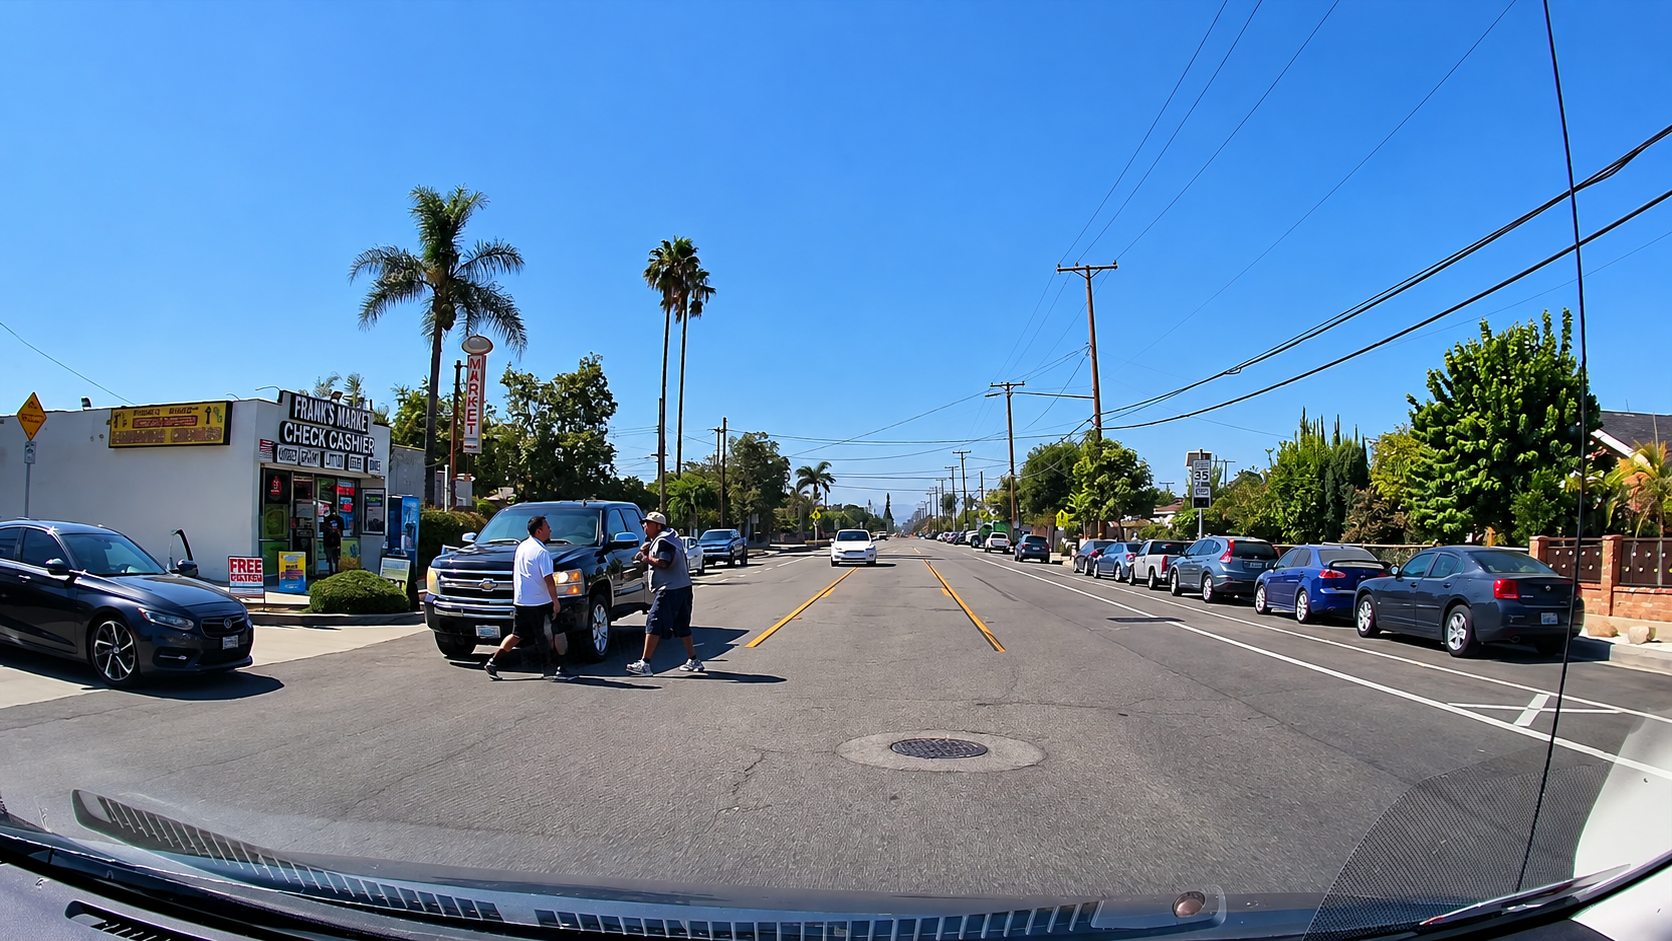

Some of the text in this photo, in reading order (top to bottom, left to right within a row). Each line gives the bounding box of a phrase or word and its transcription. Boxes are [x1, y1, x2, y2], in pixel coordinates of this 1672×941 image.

[466, 357, 481, 435] MARKET
[294, 395, 371, 433] FRANK'S MARKET
[284, 422, 375, 454] CHECK CASHIER
[1194, 471, 1209, 480] 35
[229, 558, 263, 574] FREE
